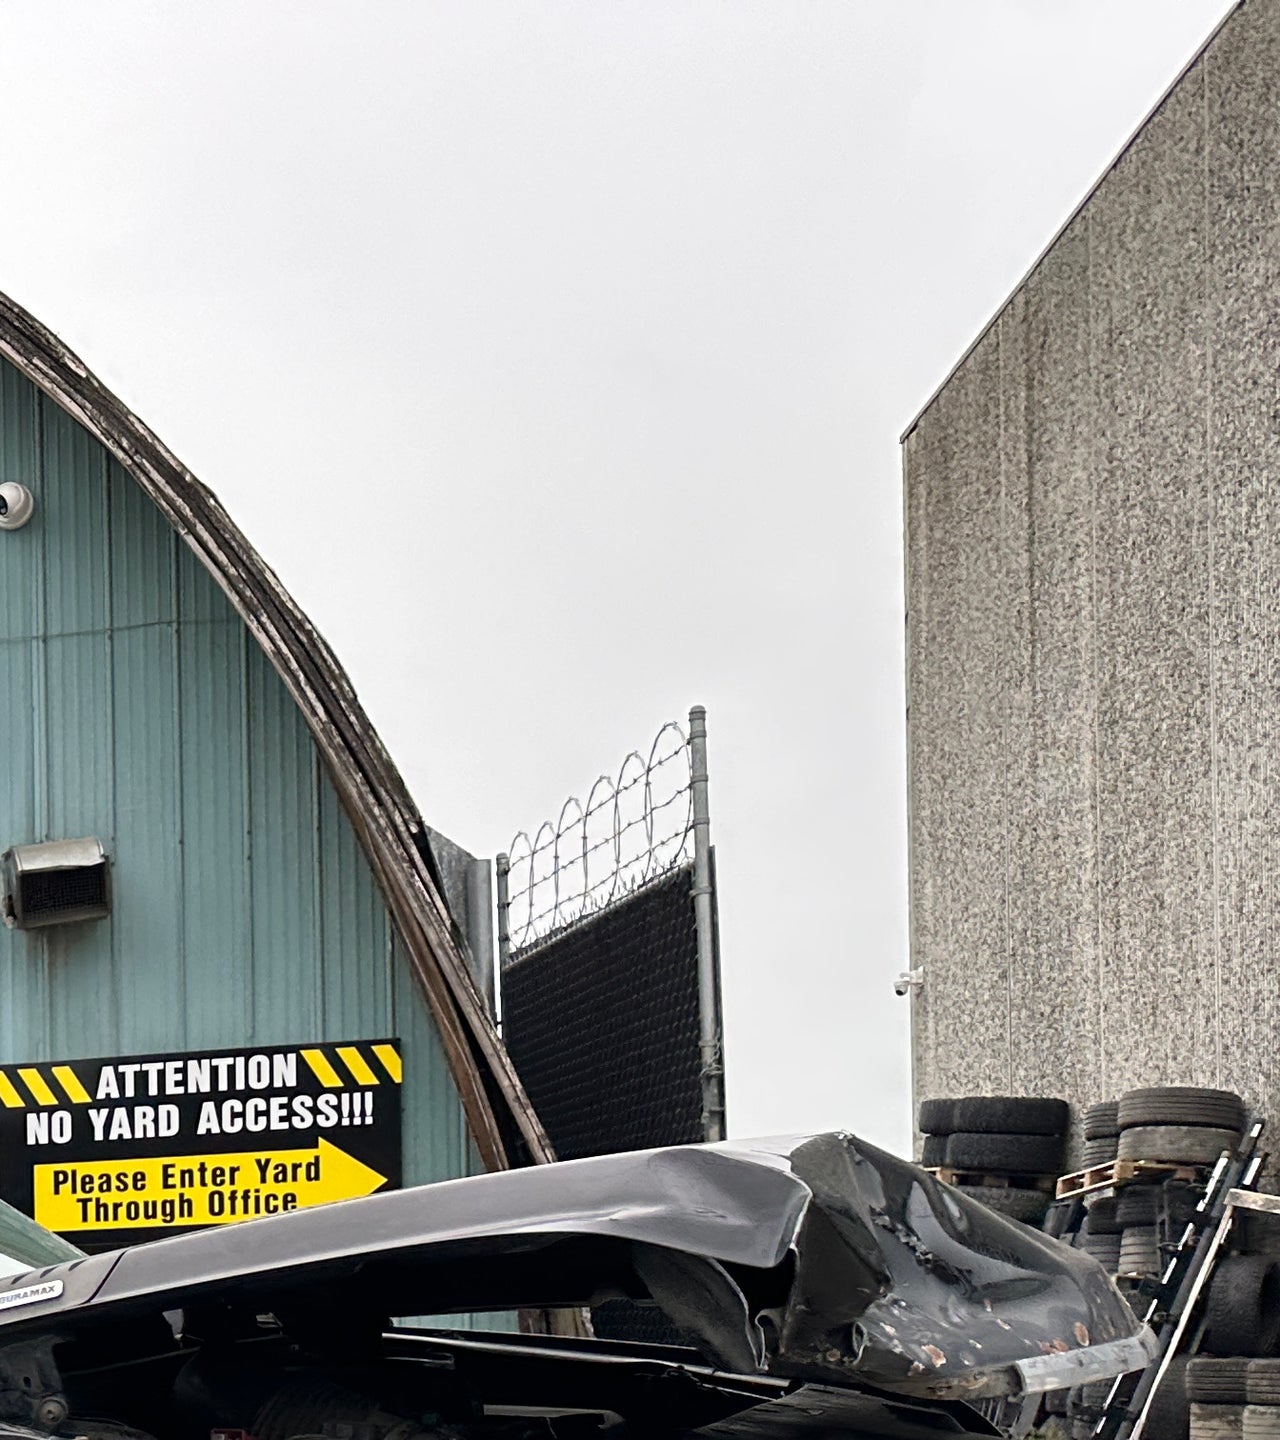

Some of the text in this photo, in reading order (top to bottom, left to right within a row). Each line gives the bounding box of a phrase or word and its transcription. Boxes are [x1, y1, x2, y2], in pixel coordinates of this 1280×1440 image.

[95, 1053, 298, 1100] ATTENTION
[26, 1091, 375, 1145] NO YARD ACCESS!!!
[53, 1155, 321, 1195] Please Enter Yard
[76, 1188, 298, 1224] Through Office
